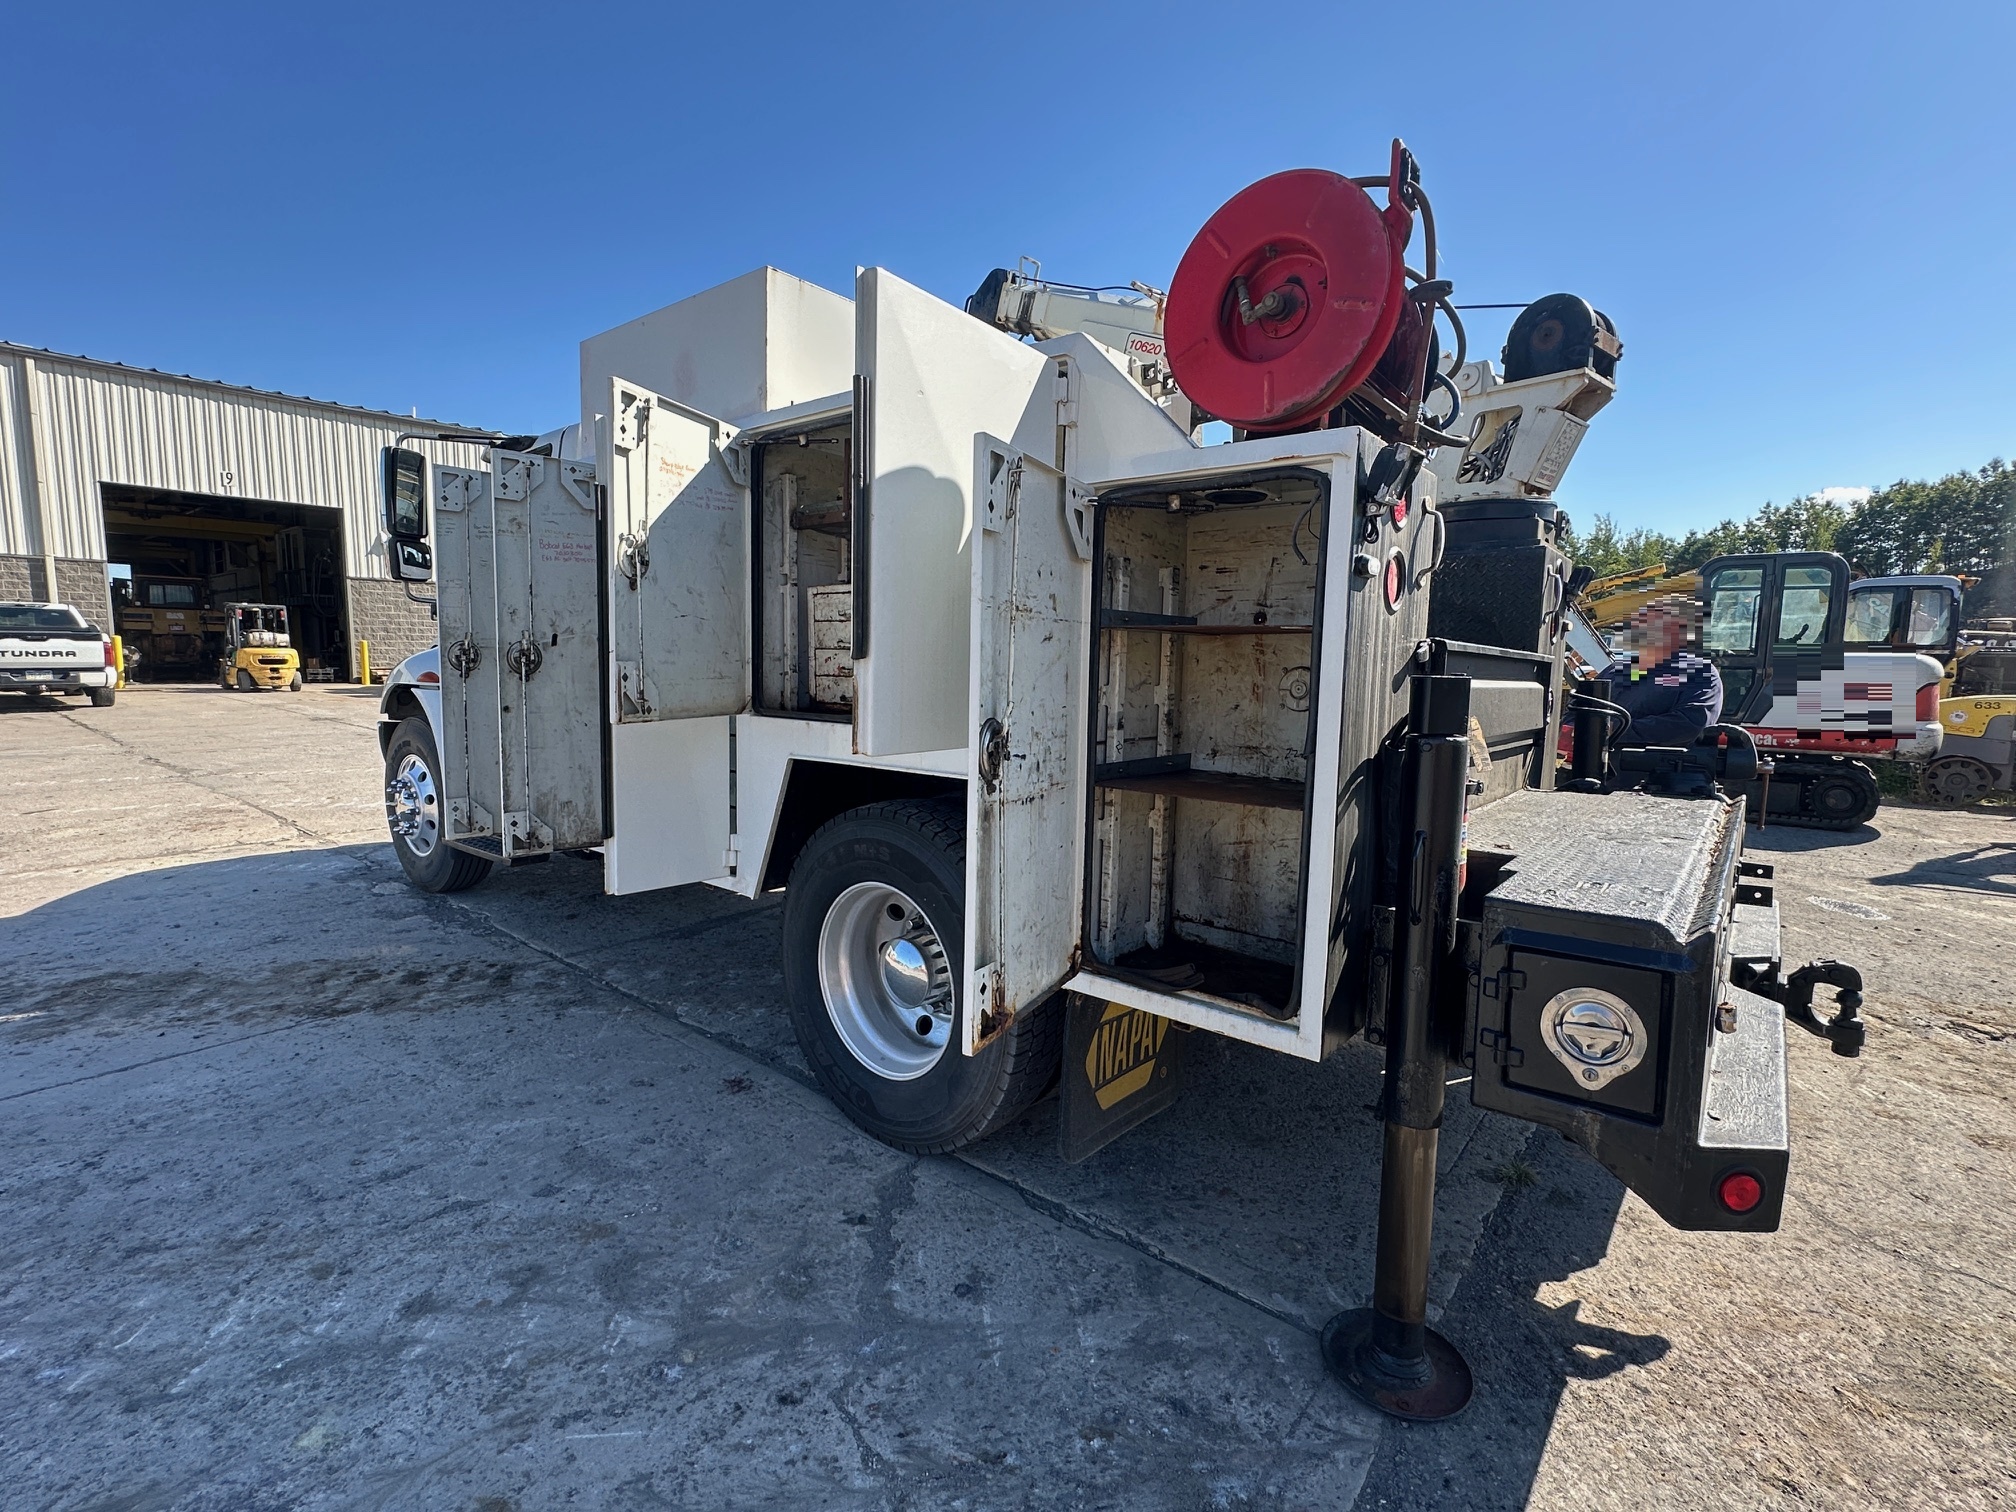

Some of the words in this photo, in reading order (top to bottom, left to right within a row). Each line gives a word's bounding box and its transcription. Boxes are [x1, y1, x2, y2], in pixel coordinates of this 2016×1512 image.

[1130, 339, 1162, 355] 10620
[0, 650, 77, 658] TUNDRA
[1974, 701, 2002, 710] 633
[1098, 1010, 1154, 1085] NAPA
